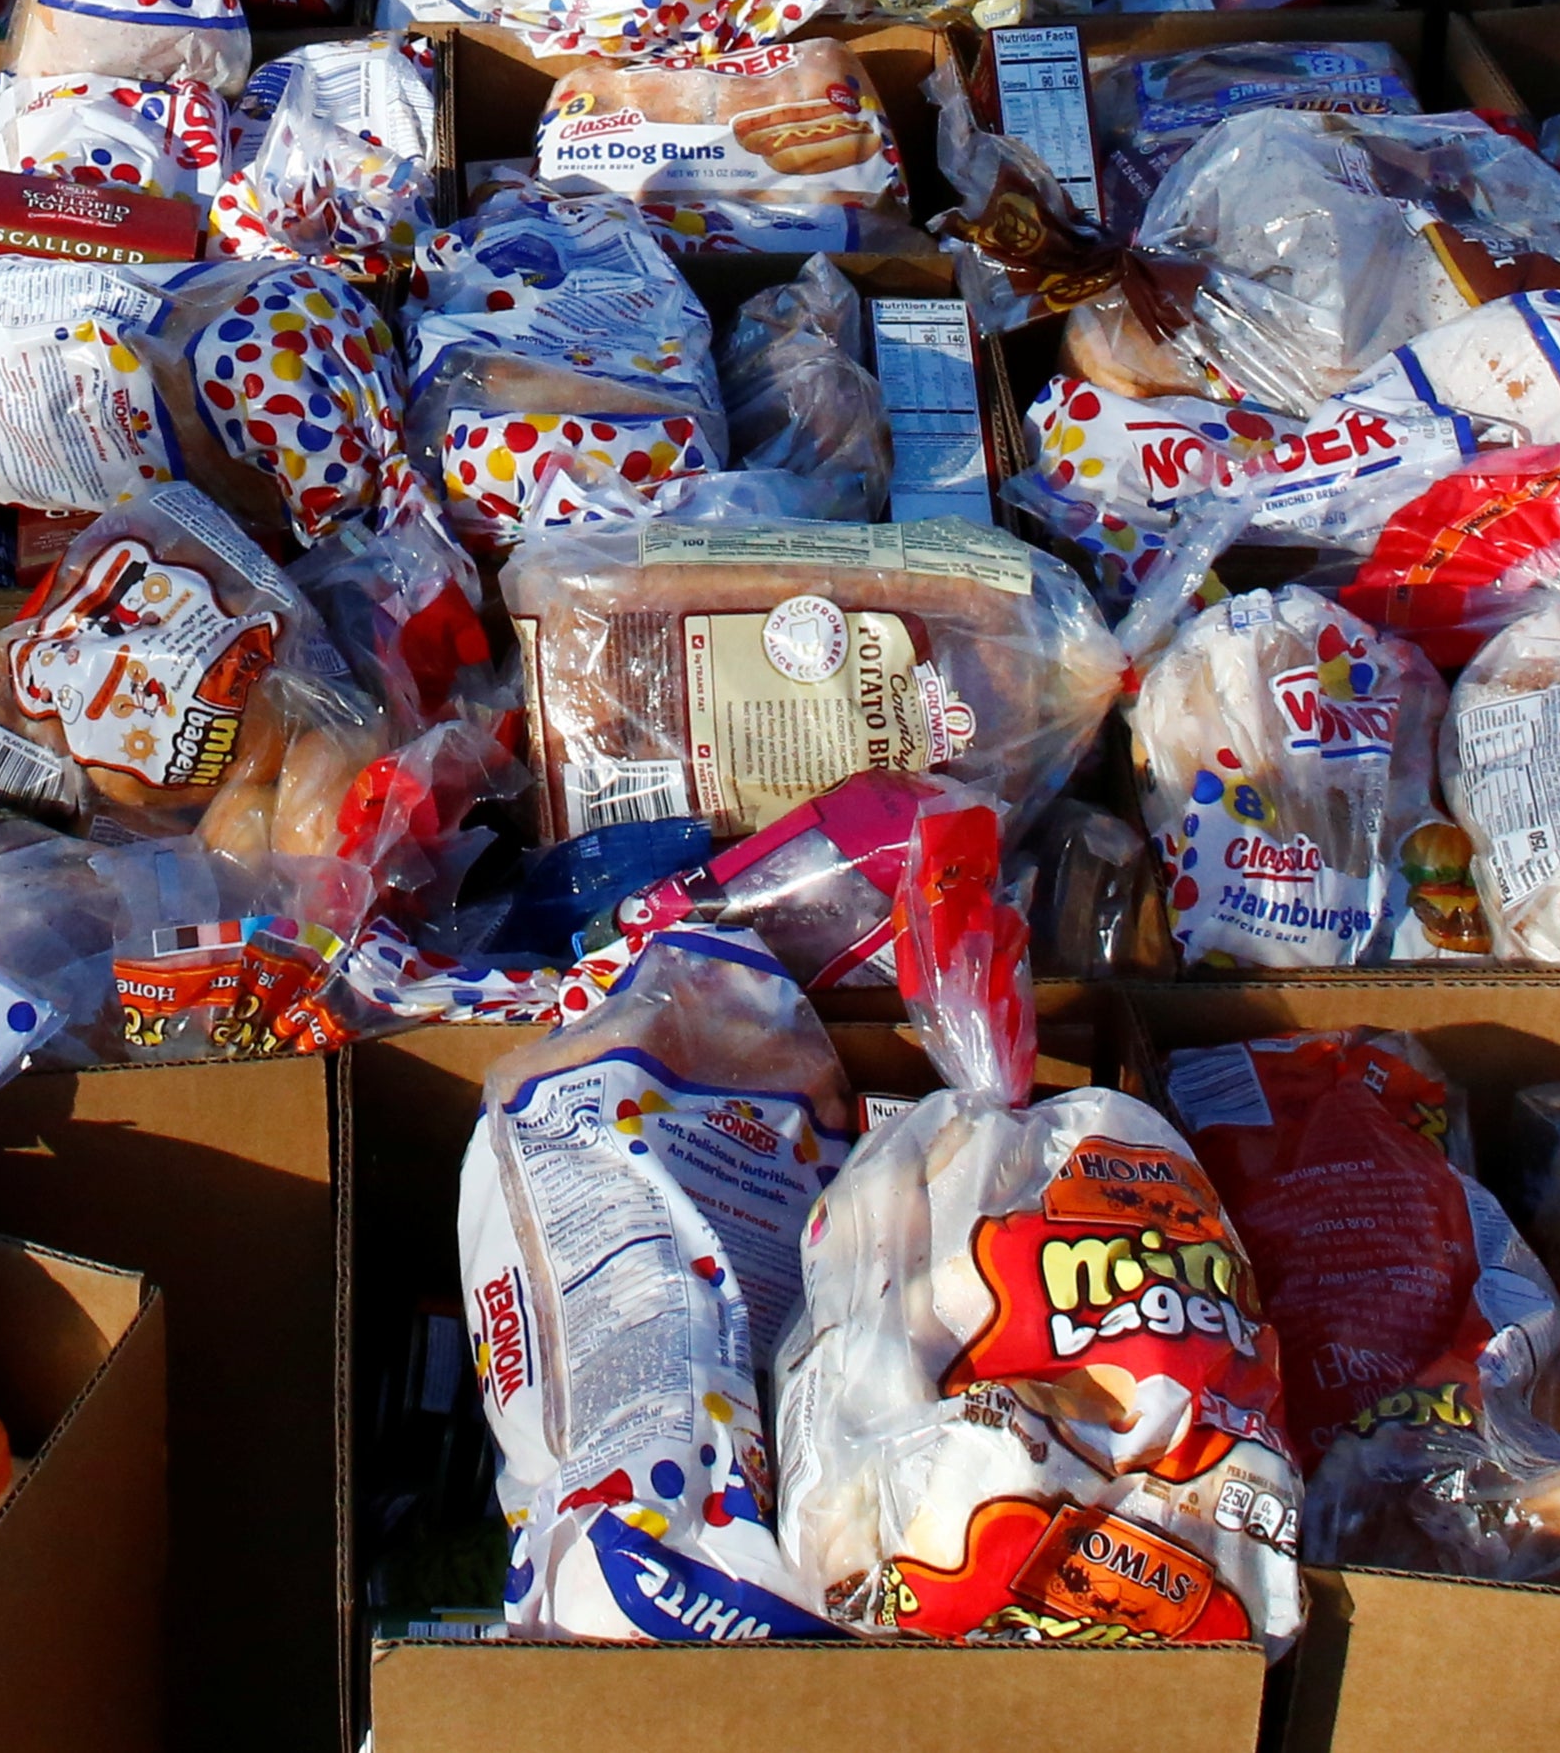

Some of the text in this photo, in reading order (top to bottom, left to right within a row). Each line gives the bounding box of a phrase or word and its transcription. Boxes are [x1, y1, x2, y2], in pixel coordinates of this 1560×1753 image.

[997, 29, 1041, 43] Nutrition
[565, 97, 586, 115] 8
[559, 108, 642, 139] Classic
[557, 142, 725, 164] Hot Dog Buns
[22, 189, 131, 215] SCALLOPED
[27, 198, 124, 224] POTATOES
[1265, 487, 1348, 512] ENRICHED BREAD
[772, 602, 842, 672] FROM SEED TO
[858, 626, 888, 731] POTATO
[890, 673, 913, 773] Country
[923, 679, 948, 764] OROWEAT
[163, 708, 214, 786] bagels
[194, 714, 239, 787] mini
[1233, 784, 1262, 821] 8
[1224, 837, 1323, 874] Classic
[559, 1074, 602, 1098] Facts
[706, 1111, 781, 1158] WONDER
[657, 1117, 809, 1196] Soft. Delicious. Nutritious.
[667, 1142, 790, 1207] An American Classic.
[732, 1205, 782, 1235] Wonder
[1348, 1216, 1376, 1230] OUR
[488, 1276, 525, 1406] WONDER
[981, 1409, 1004, 1429] OZ
[1222, 1487, 1250, 1510] 250
